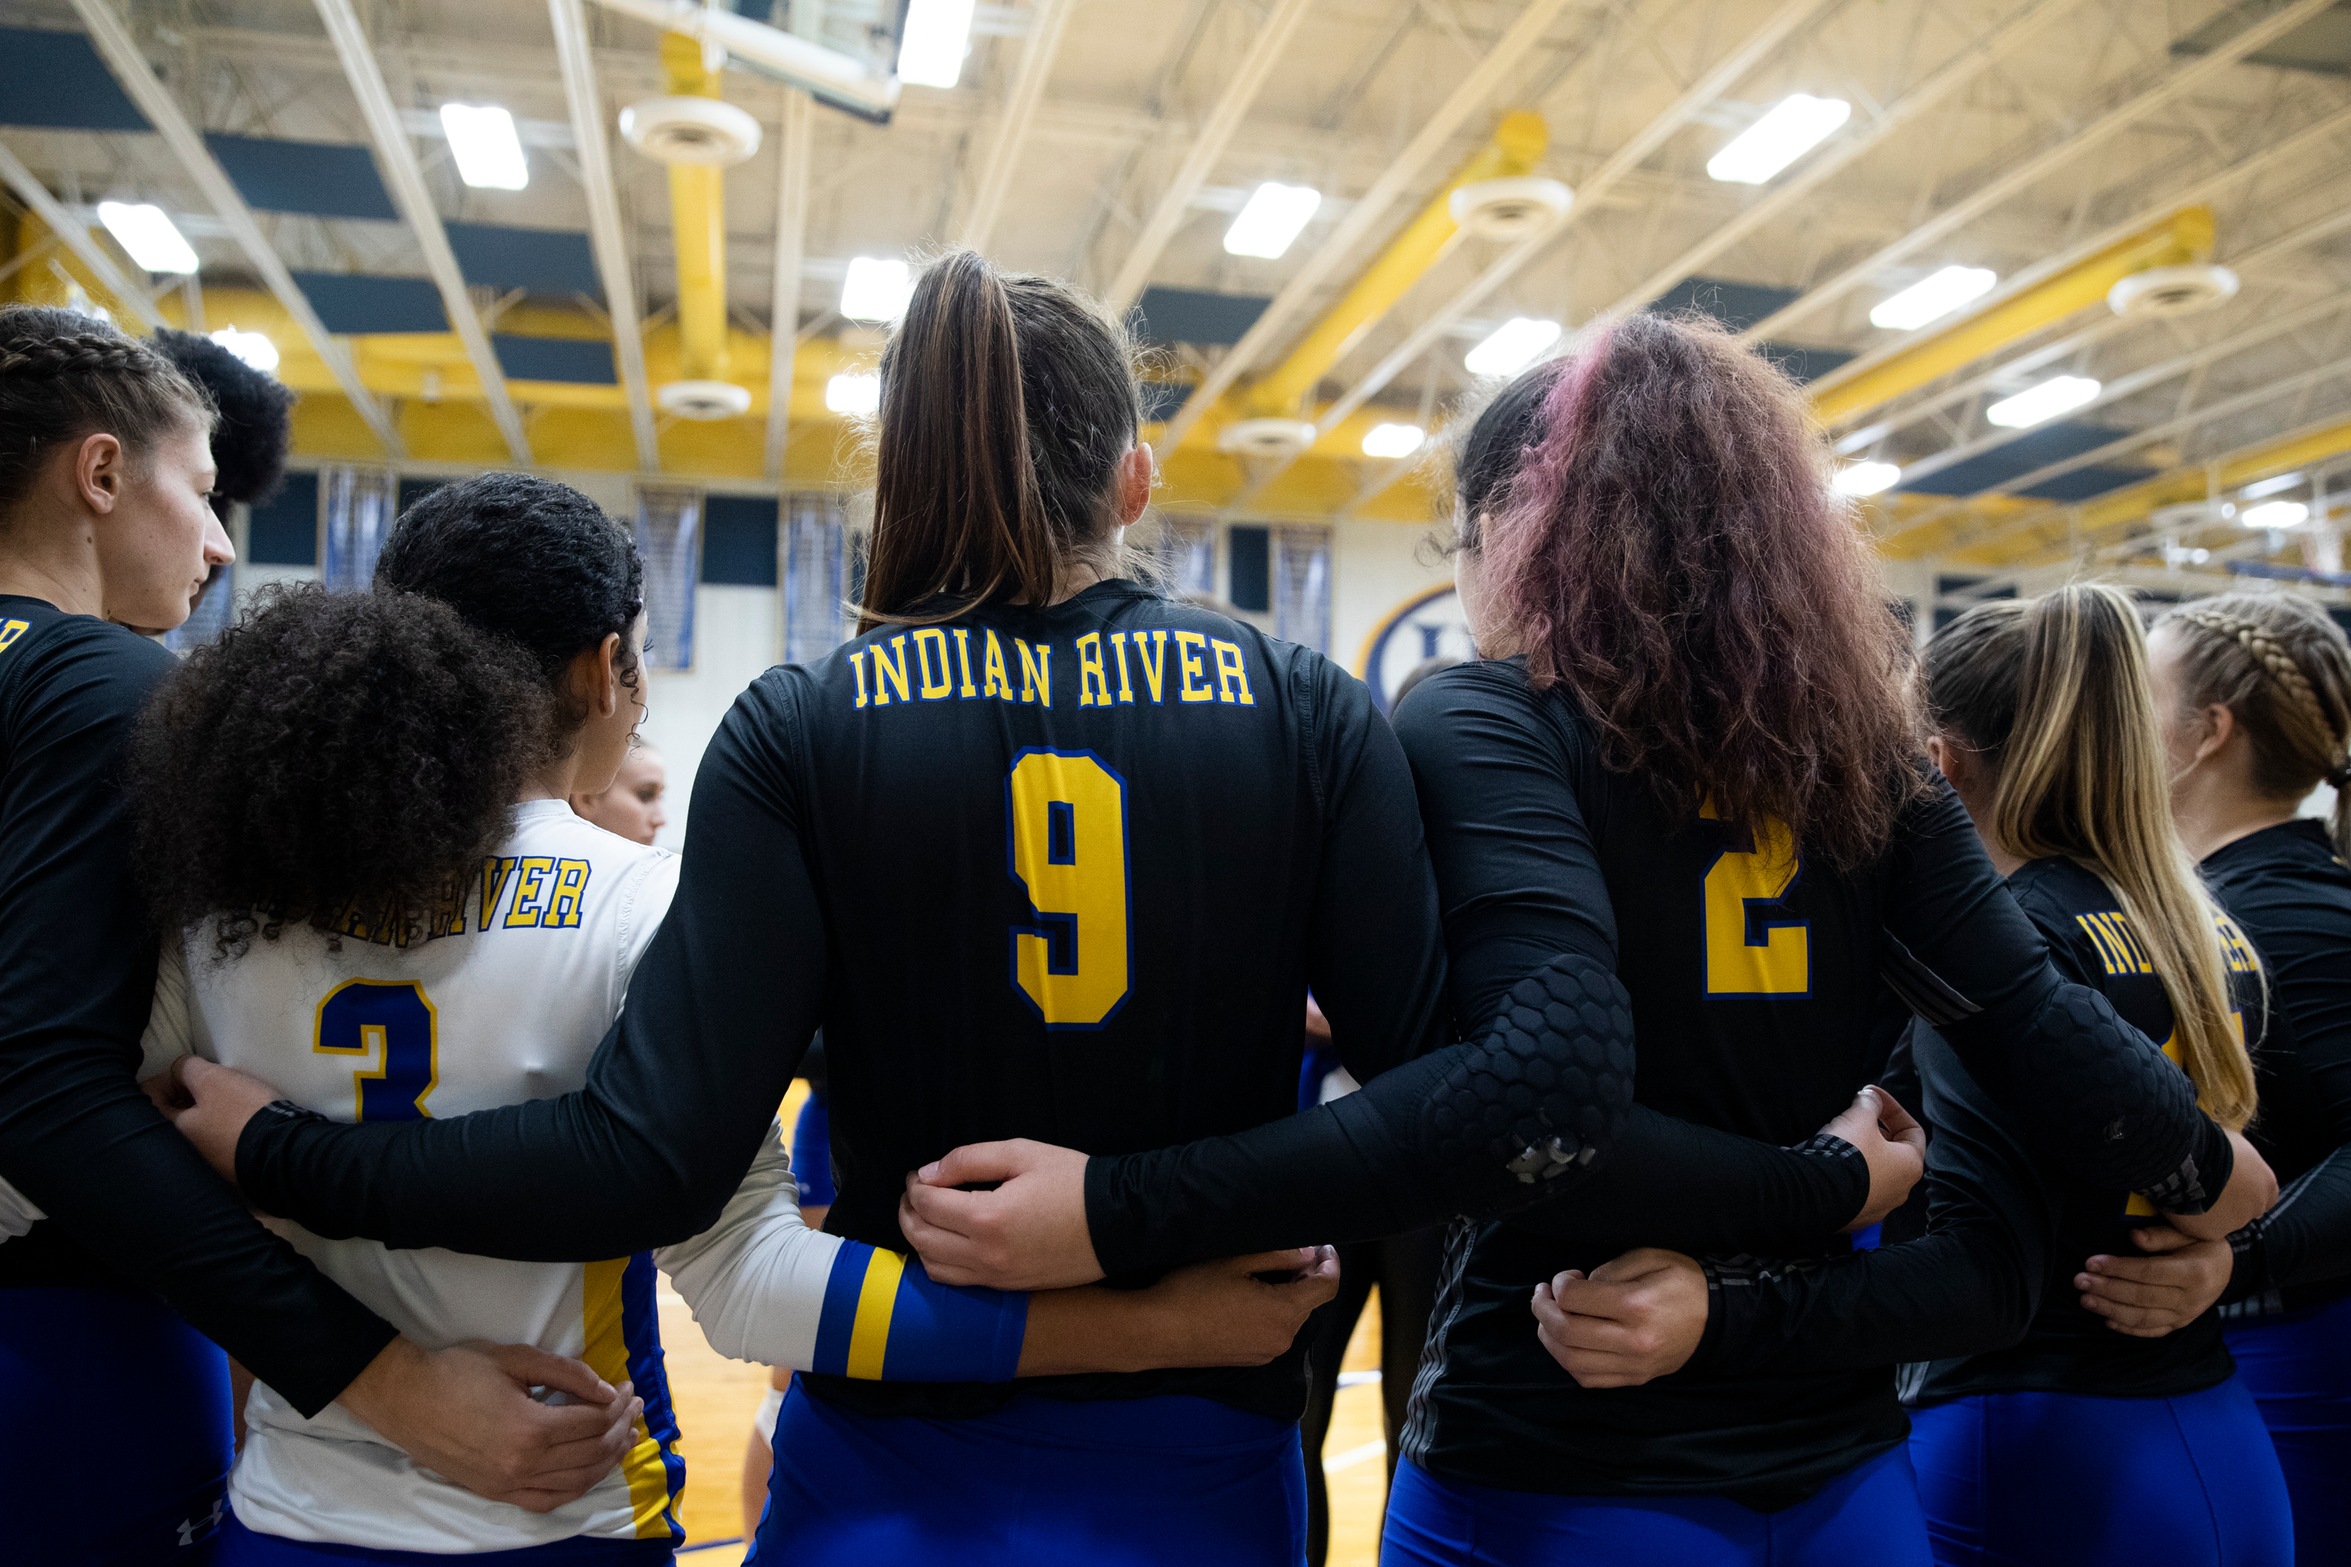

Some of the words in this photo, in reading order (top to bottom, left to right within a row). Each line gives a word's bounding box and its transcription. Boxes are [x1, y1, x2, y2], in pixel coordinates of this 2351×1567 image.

[848, 626, 1053, 711] INDIAN
[1075, 627, 1257, 710] RIVER
[1004, 745, 1134, 1032] 9
[1697, 780, 1812, 1001] 2
[313, 977, 439, 1123] 3
